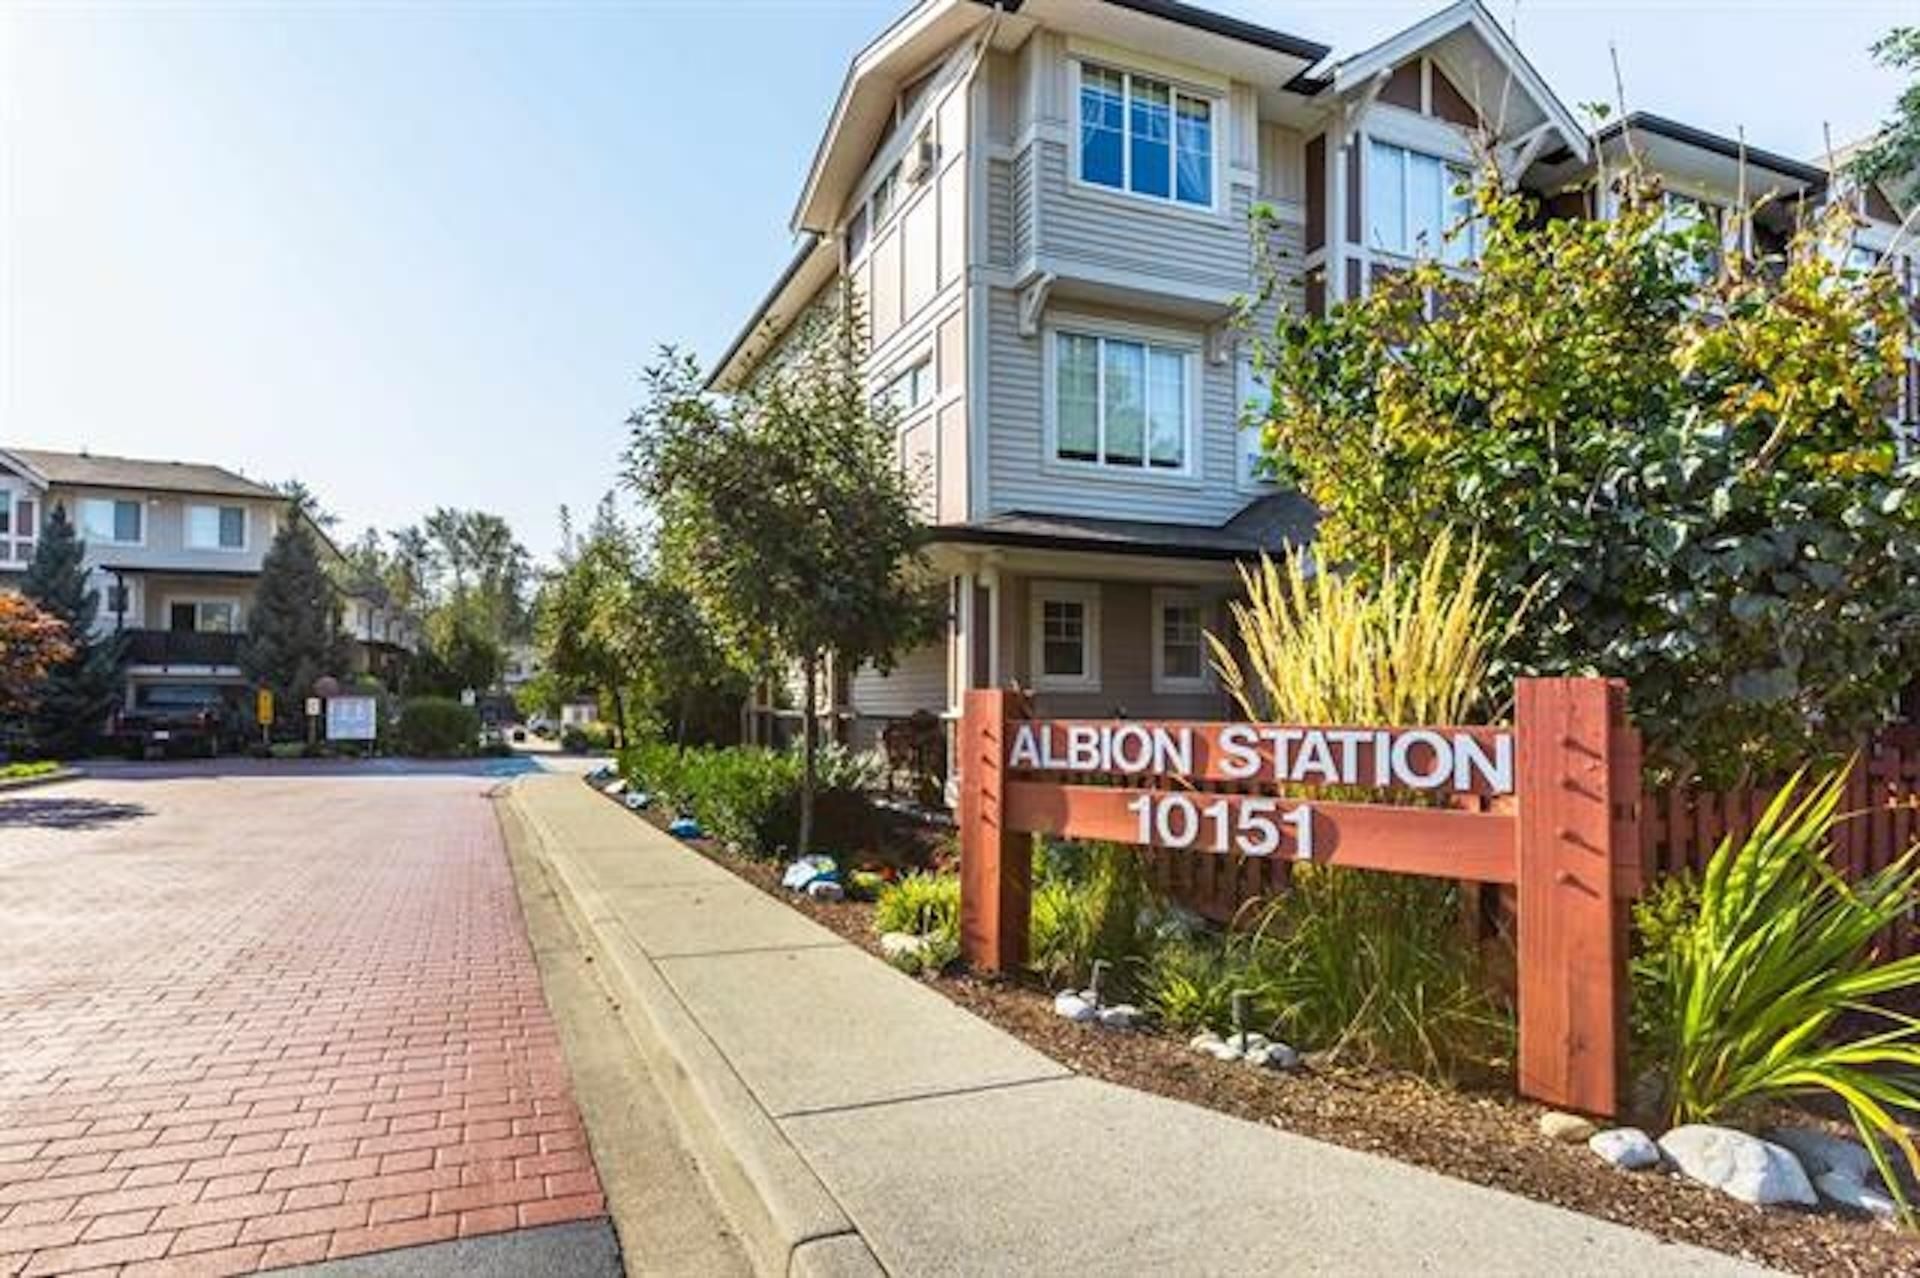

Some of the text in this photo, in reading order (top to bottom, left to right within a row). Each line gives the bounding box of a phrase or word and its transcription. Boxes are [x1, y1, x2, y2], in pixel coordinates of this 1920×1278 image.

[1009, 723, 1514, 793] ALBION STATION
[1127, 795, 1314, 860] 10151
